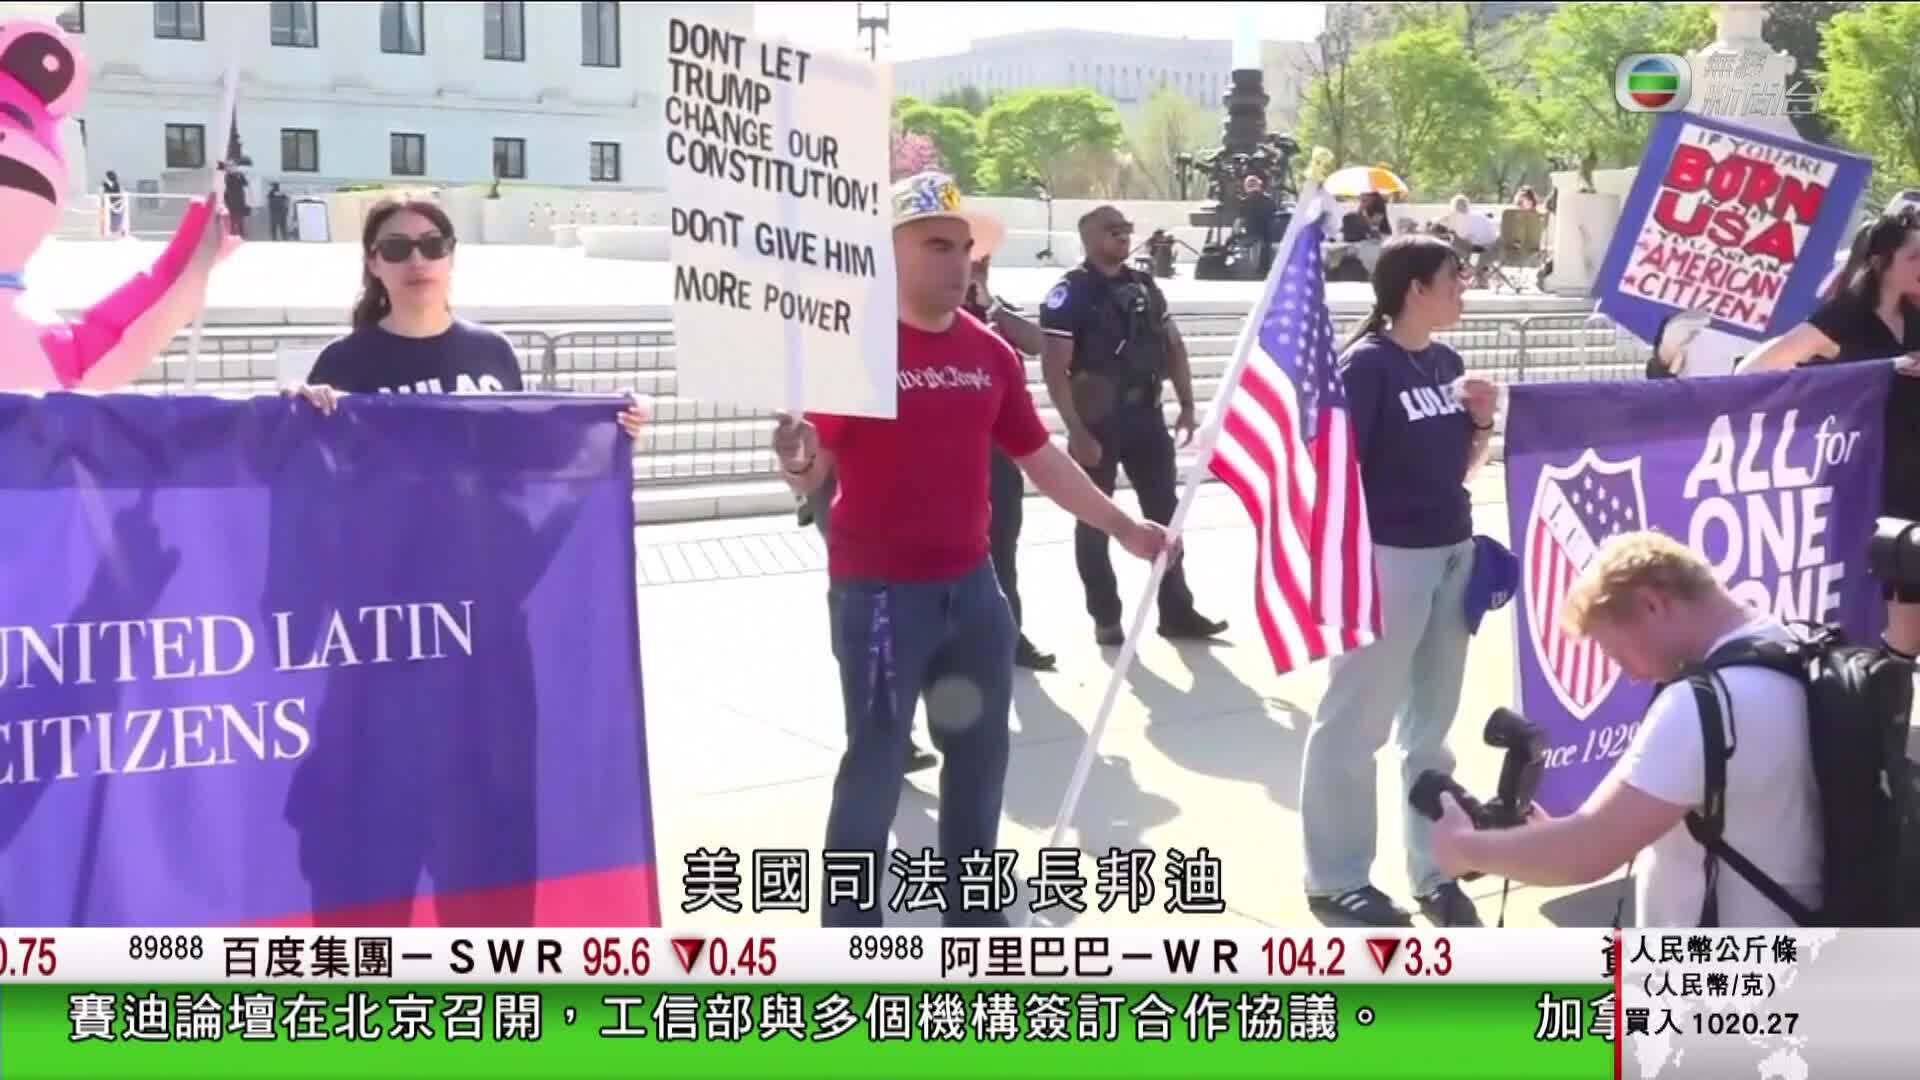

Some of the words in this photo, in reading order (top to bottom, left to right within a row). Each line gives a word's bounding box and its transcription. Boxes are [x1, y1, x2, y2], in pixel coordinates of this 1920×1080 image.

[668, 18, 746, 69] DONT
[761, 42, 811, 84] LET
[668, 57, 771, 116] TRUMP
[665, 95, 773, 152] CHANGE
[788, 129, 839, 169] OUR
[666, 130, 879, 216] CONSTITUTION!
[1664, 143, 1825, 225] BORN
[755, 221, 817, 266] GIVE
[824, 235, 876, 278] HIM
[1653, 190, 1797, 264] USA
[1638, 243, 1783, 300] AMERICAN
[1638, 272, 1756, 322] CITIZEN
[764, 283, 850, 335] POWER
[1399, 384, 1464, 421] LULA
[1683, 409, 1810, 498] ALL
[1807, 415, 1861, 484] for
[1688, 486, 1834, 587] ONE
[272, 602, 474, 672] LATIN
